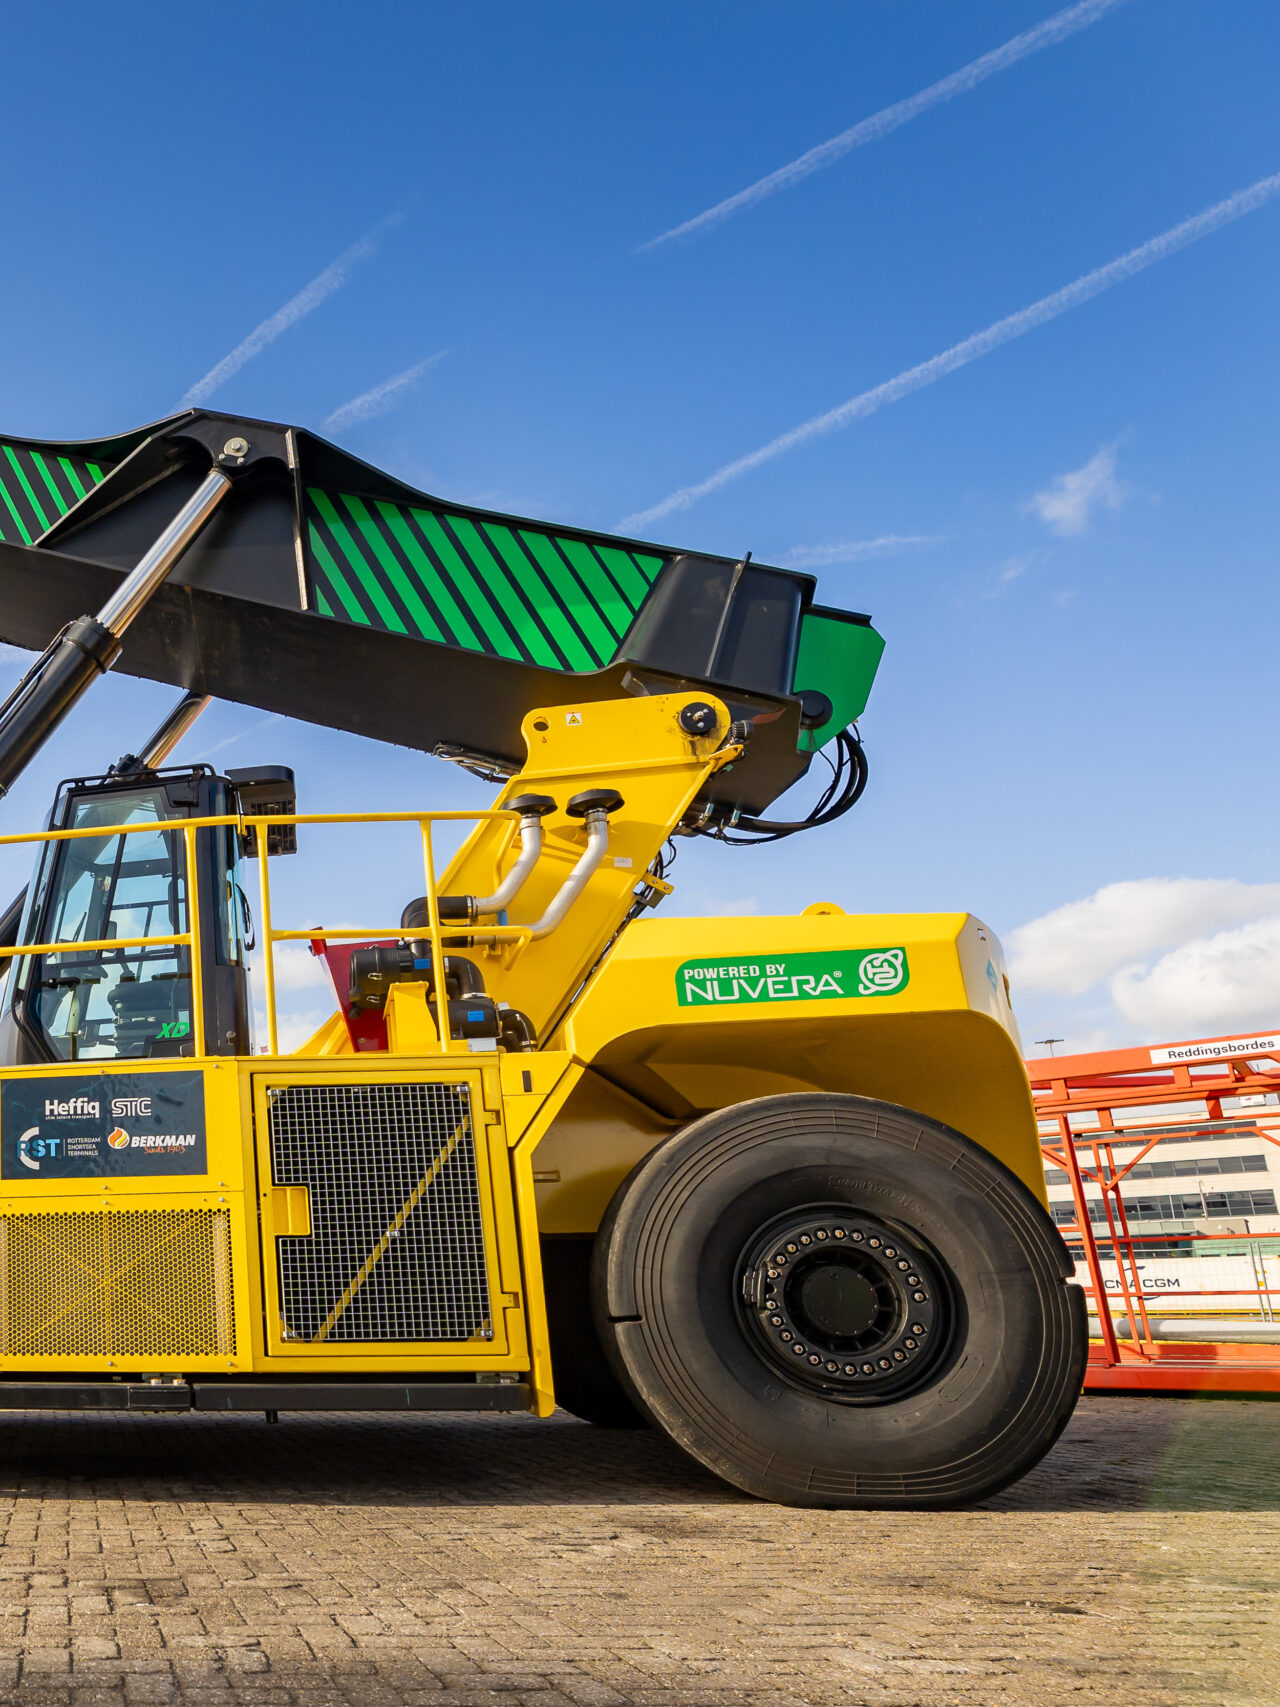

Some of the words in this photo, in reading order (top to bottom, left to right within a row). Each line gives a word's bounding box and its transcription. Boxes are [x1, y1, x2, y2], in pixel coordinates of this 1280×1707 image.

[684, 965, 760, 981] POWERED
[766, 963, 787, 976] BY
[156, 1022, 190, 1039] XD
[1167, 1040, 1275, 1059] Reddingsbordes
[45, 1097, 100, 1118] Heffiq
[111, 1097, 152, 1117] STC
[17, 1138, 60, 1158] RST
[130, 1134, 196, 1148] BERKMAN
[143, 1145, 165, 1154] Sinds
[167, 1145, 186, 1154] 1903
[1143, 1278, 1181, 1289] CGM
